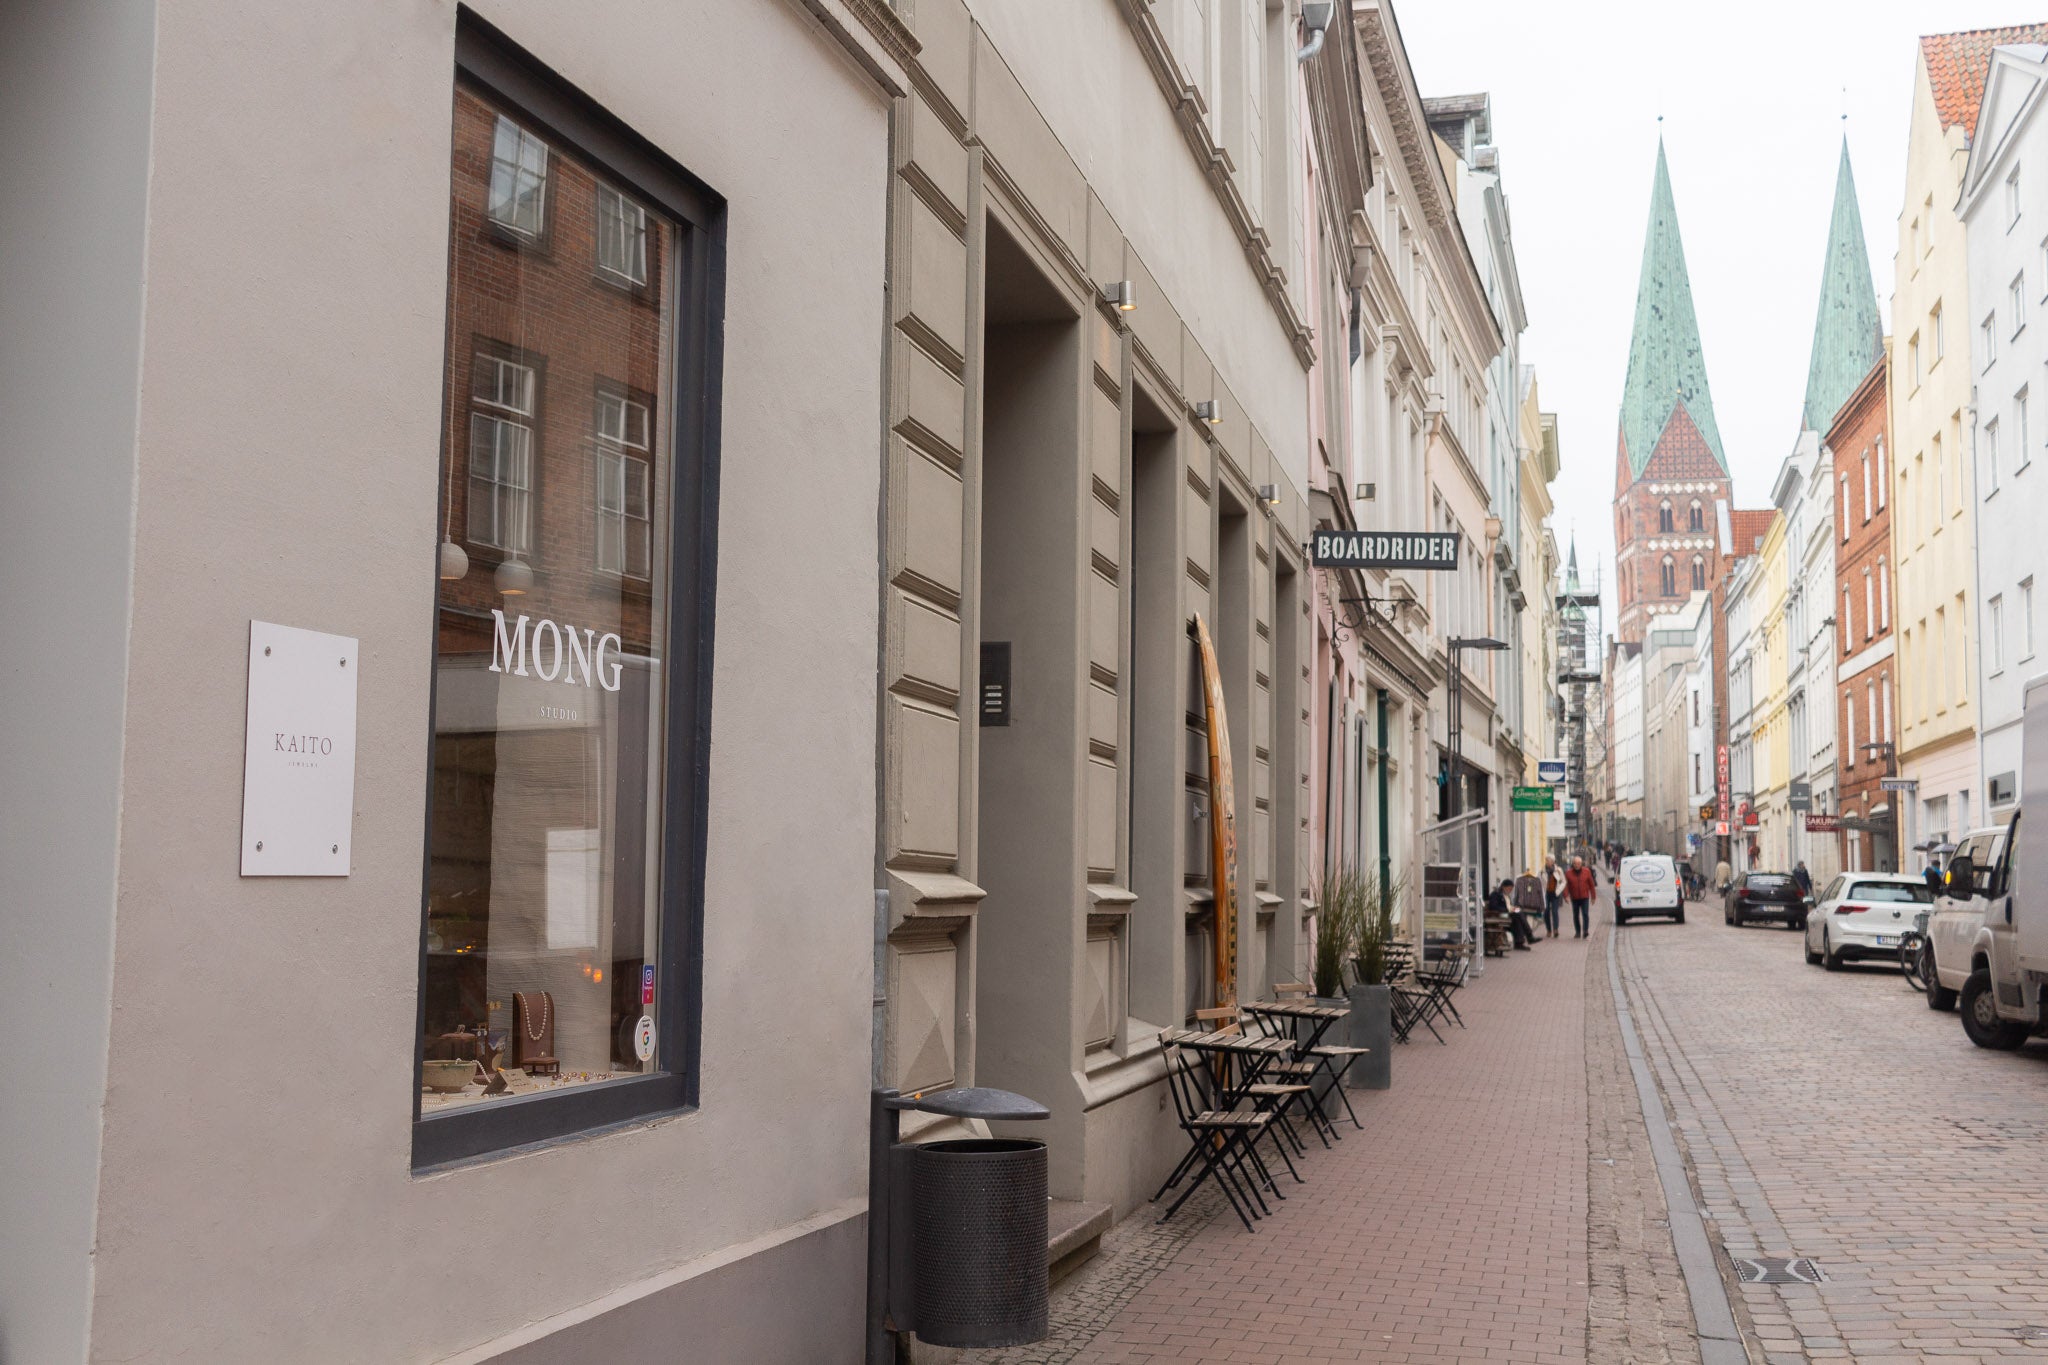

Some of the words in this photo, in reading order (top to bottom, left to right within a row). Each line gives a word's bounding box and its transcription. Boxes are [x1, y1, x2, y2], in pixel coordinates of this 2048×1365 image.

[1317, 536, 1455, 561] BOARDRIDER
[488, 608, 623, 691] MONG
[540, 706, 577, 720] STUDIO
[275, 733, 332, 755] KAITO
[1719, 746, 1728, 820] APOTHEKE
